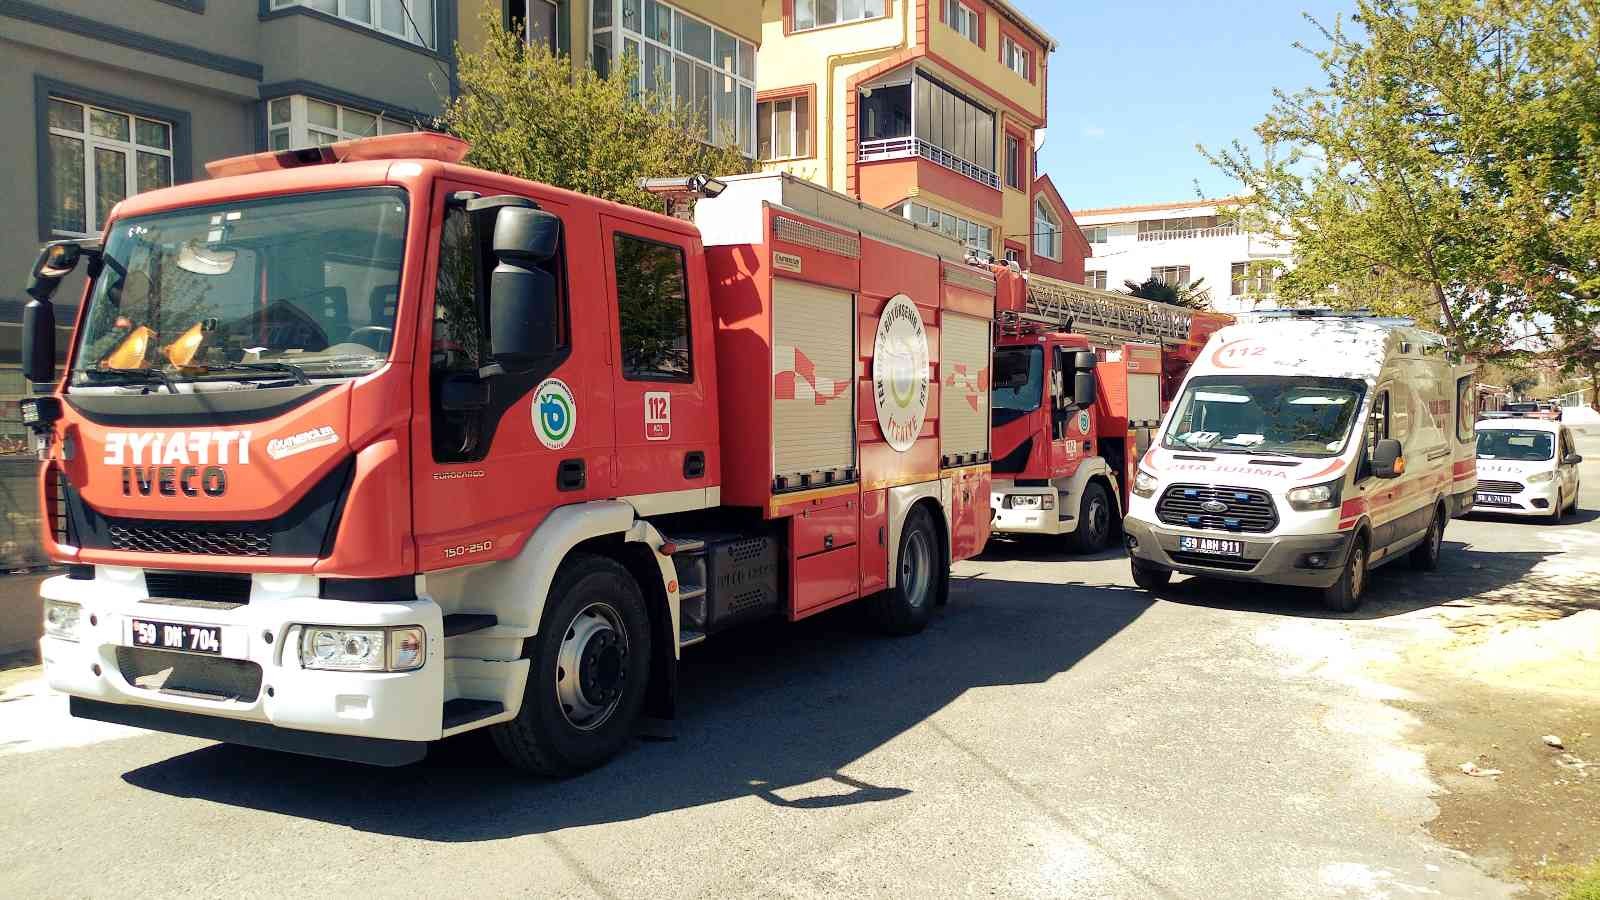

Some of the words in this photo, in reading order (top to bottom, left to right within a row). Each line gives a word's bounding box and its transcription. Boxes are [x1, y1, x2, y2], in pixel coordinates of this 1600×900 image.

[1227, 346, 1266, 357] 112
[648, 397, 667, 419] 112
[121, 466, 228, 497] IVECO
[444, 541, 492, 558] 150-250
[1186, 537, 1198, 548] 59
[1201, 539, 1219, 551] ABH
[1222, 541, 1240, 552] 911
[139, 622, 157, 645] 59
[190, 628, 219, 652] 704
